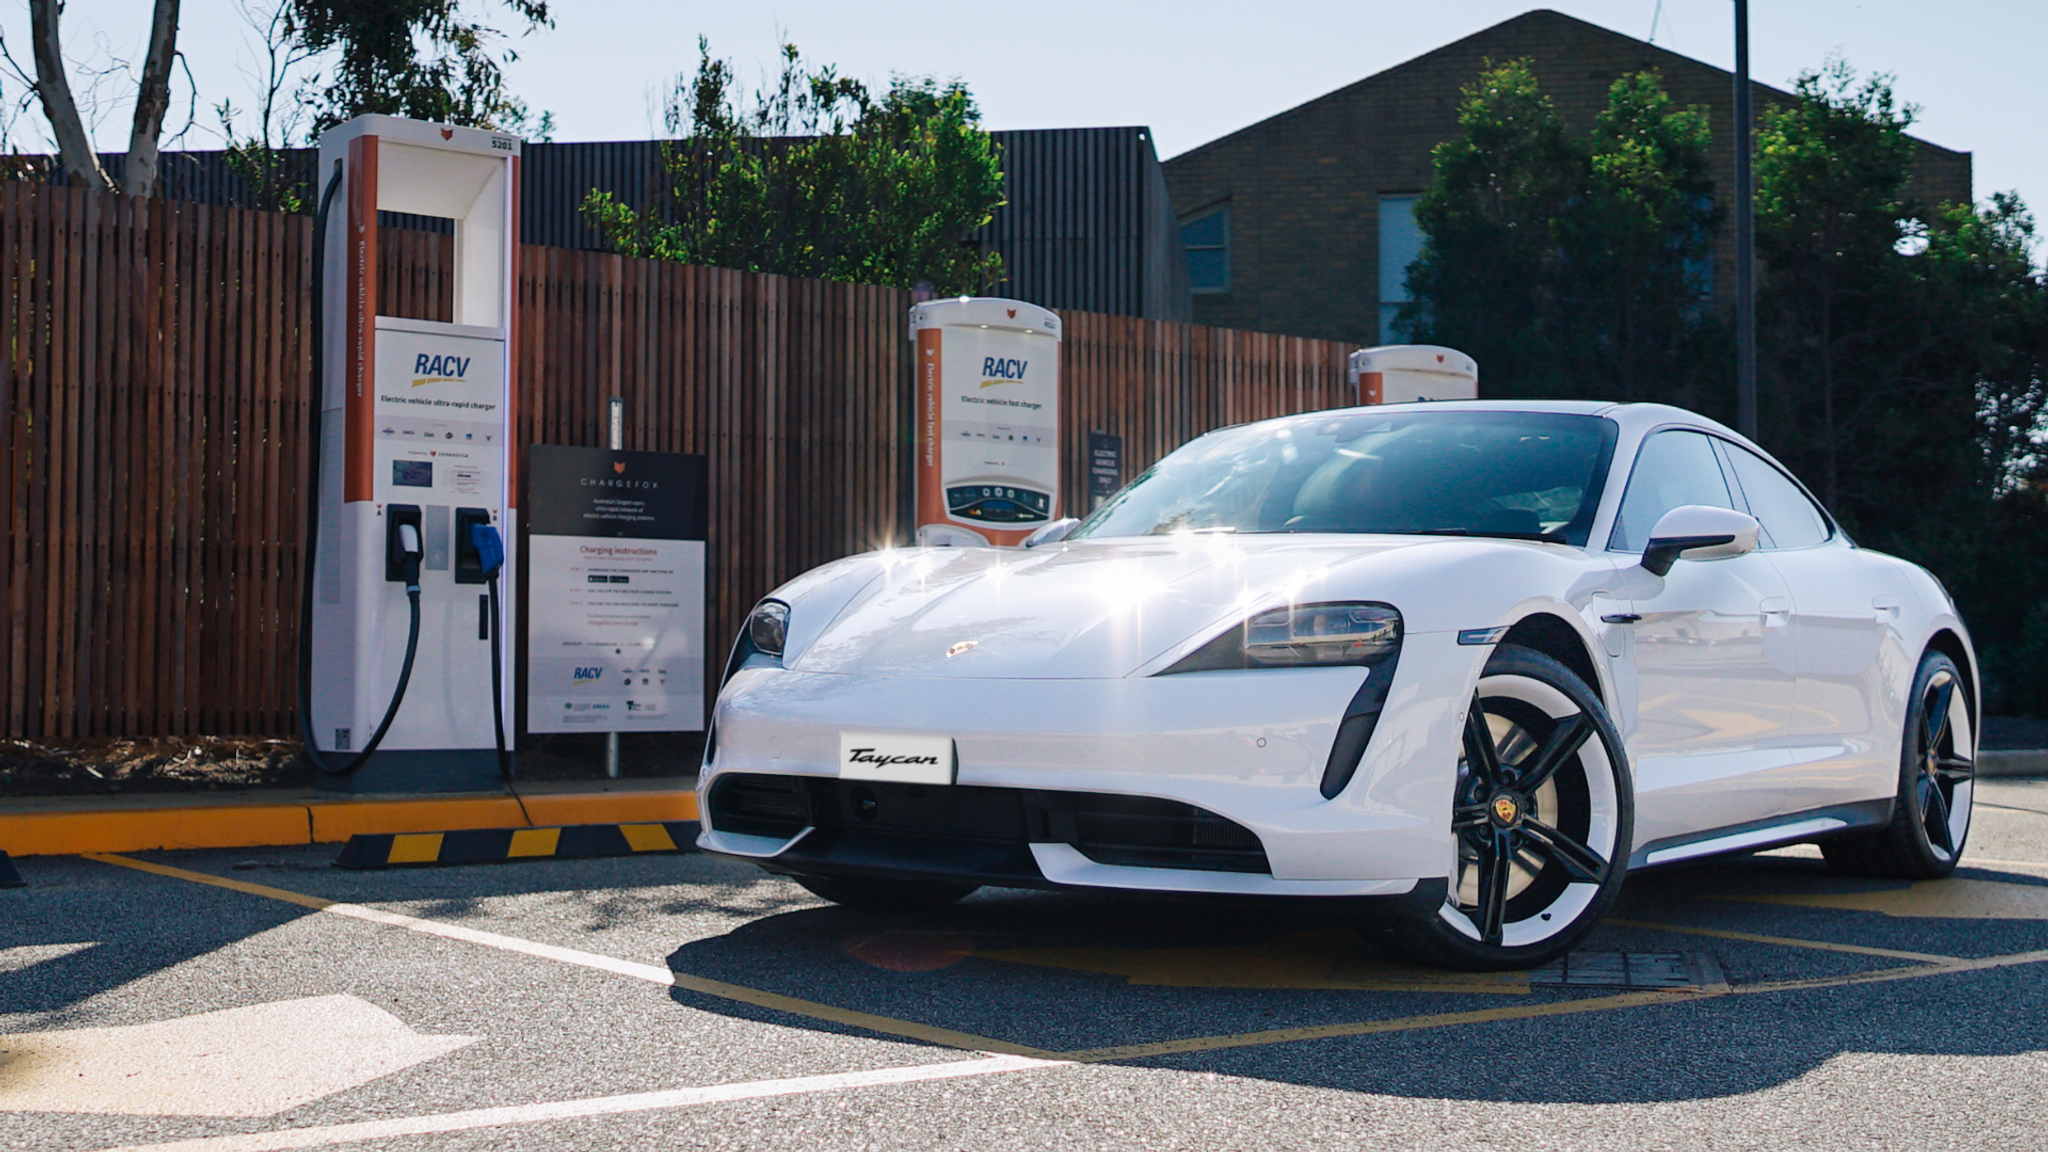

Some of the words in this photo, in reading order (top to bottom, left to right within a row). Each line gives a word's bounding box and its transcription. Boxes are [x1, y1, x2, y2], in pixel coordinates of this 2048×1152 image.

[492, 140, 513, 150] 5201
[414, 353, 471, 378] RACV
[982, 356, 1028, 379] RACV
[381, 395, 407, 404] Electric
[407, 397, 432, 406] vehicle
[433, 399, 470, 409] ultra-rapid
[470, 402, 496, 411] charger
[961, 395, 985, 404] Electric
[986, 398, 1008, 406] vehicle
[1020, 401, 1042, 410] charger
[580, 477, 659, 489] CHARGEFOX
[580, 545, 613, 555] Charging
[614, 546, 658, 556] instructions
[573, 666, 603, 679] RACV
[848, 748, 939, 769] Taycan
